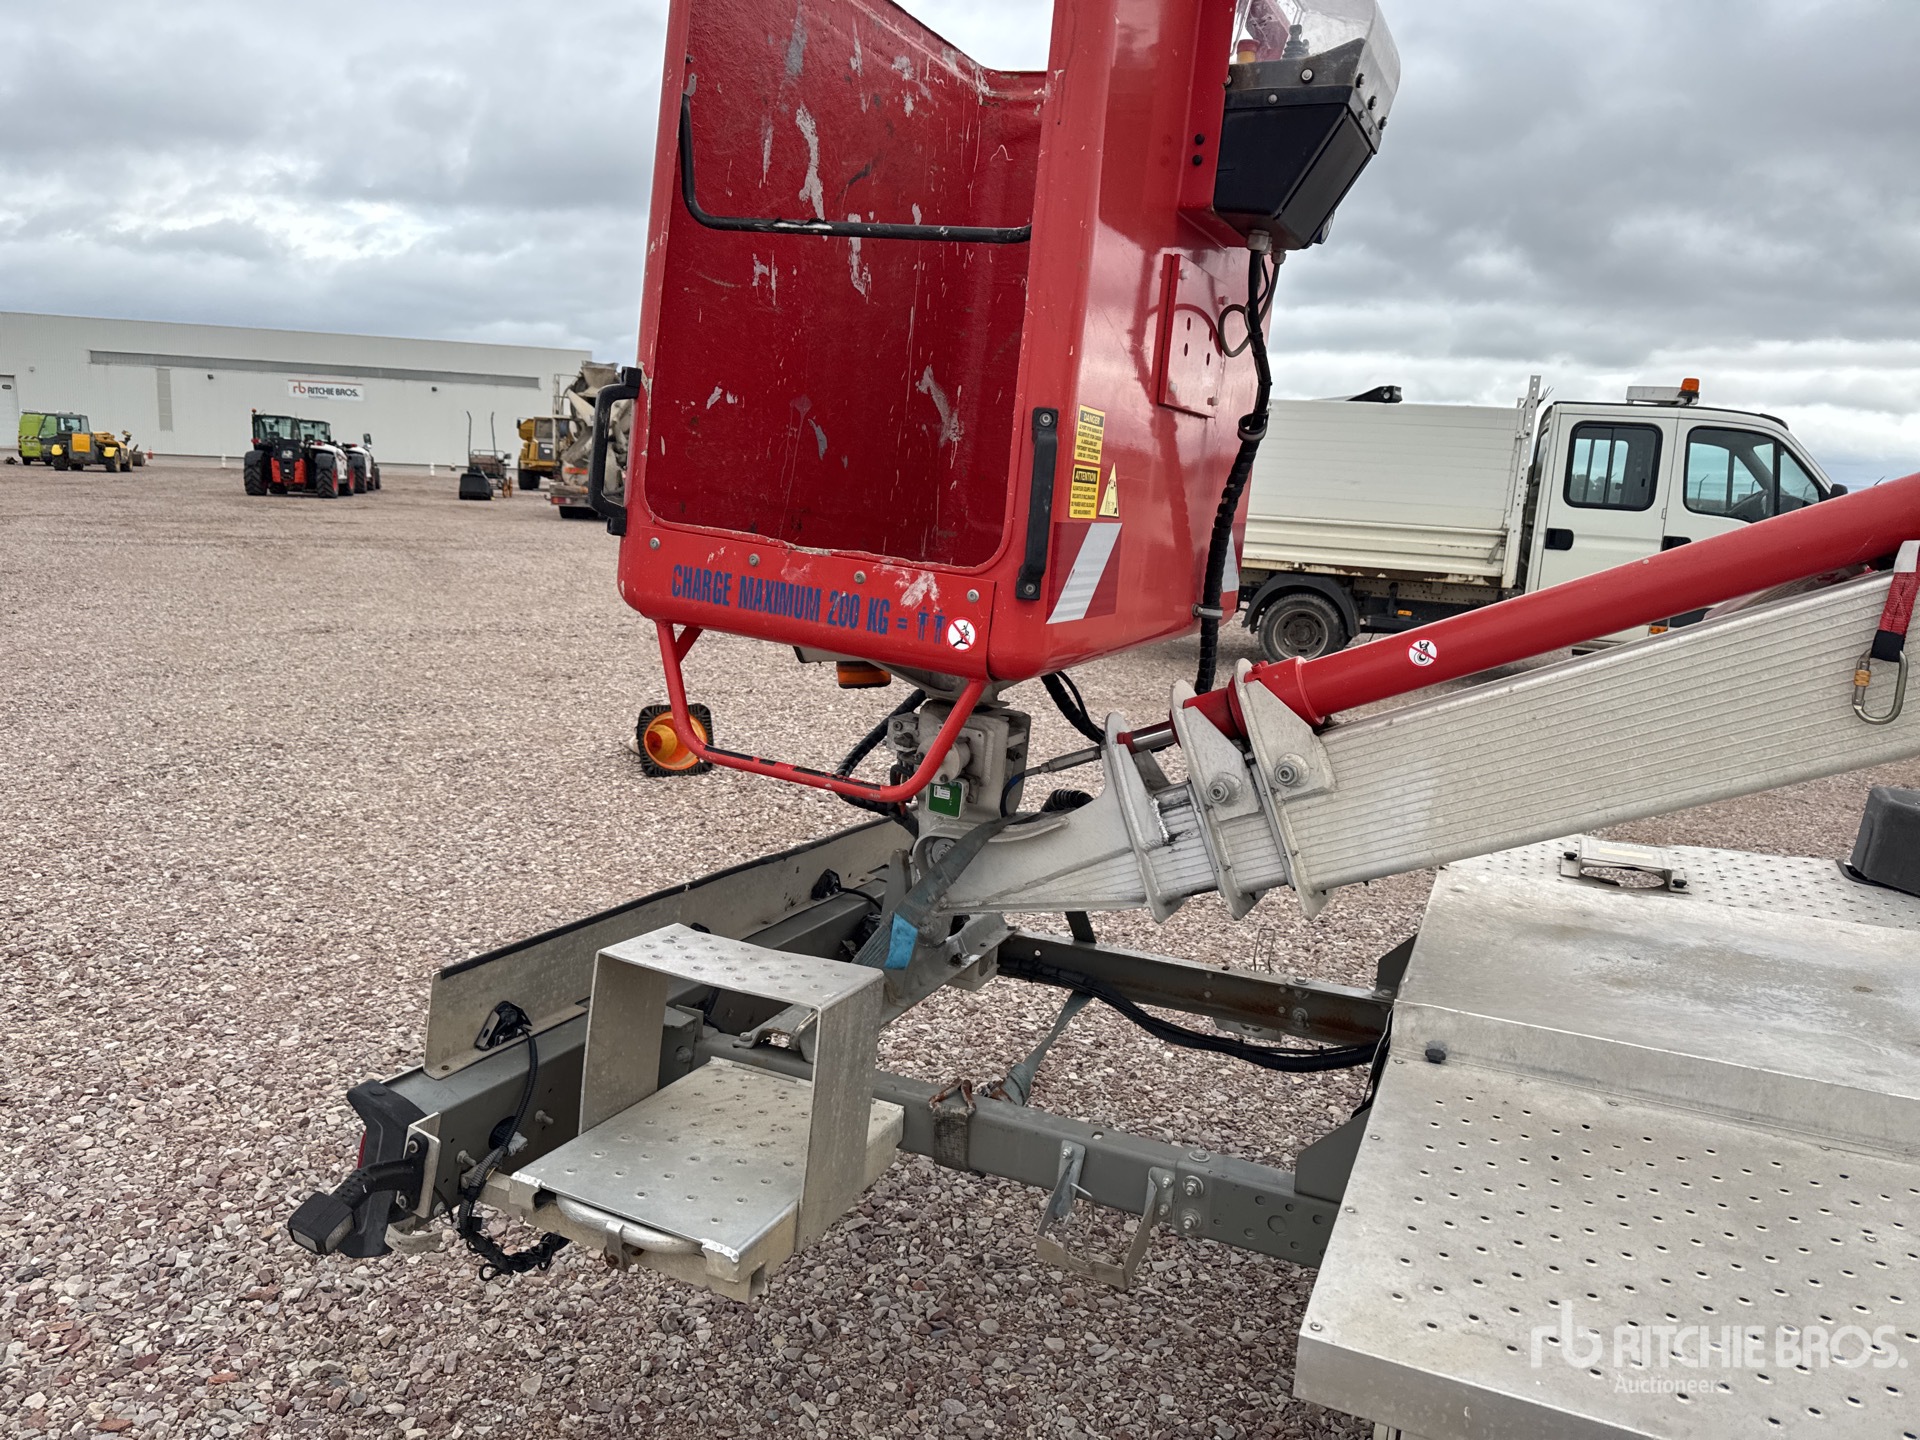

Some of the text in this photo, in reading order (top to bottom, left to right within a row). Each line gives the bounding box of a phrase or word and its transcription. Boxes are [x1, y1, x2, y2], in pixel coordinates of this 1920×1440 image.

[308, 387, 334, 395] RITCHIE
[335, 388, 359, 397] BROS.
[1083, 412, 1100, 425] DANGER
[1075, 470, 1096, 482] ATTENTION
[672, 564, 732, 606] CHARGE
[738, 575, 822, 621] MAXIMUM
[828, 590, 860, 629] 200
[867, 597, 890, 635] KG
